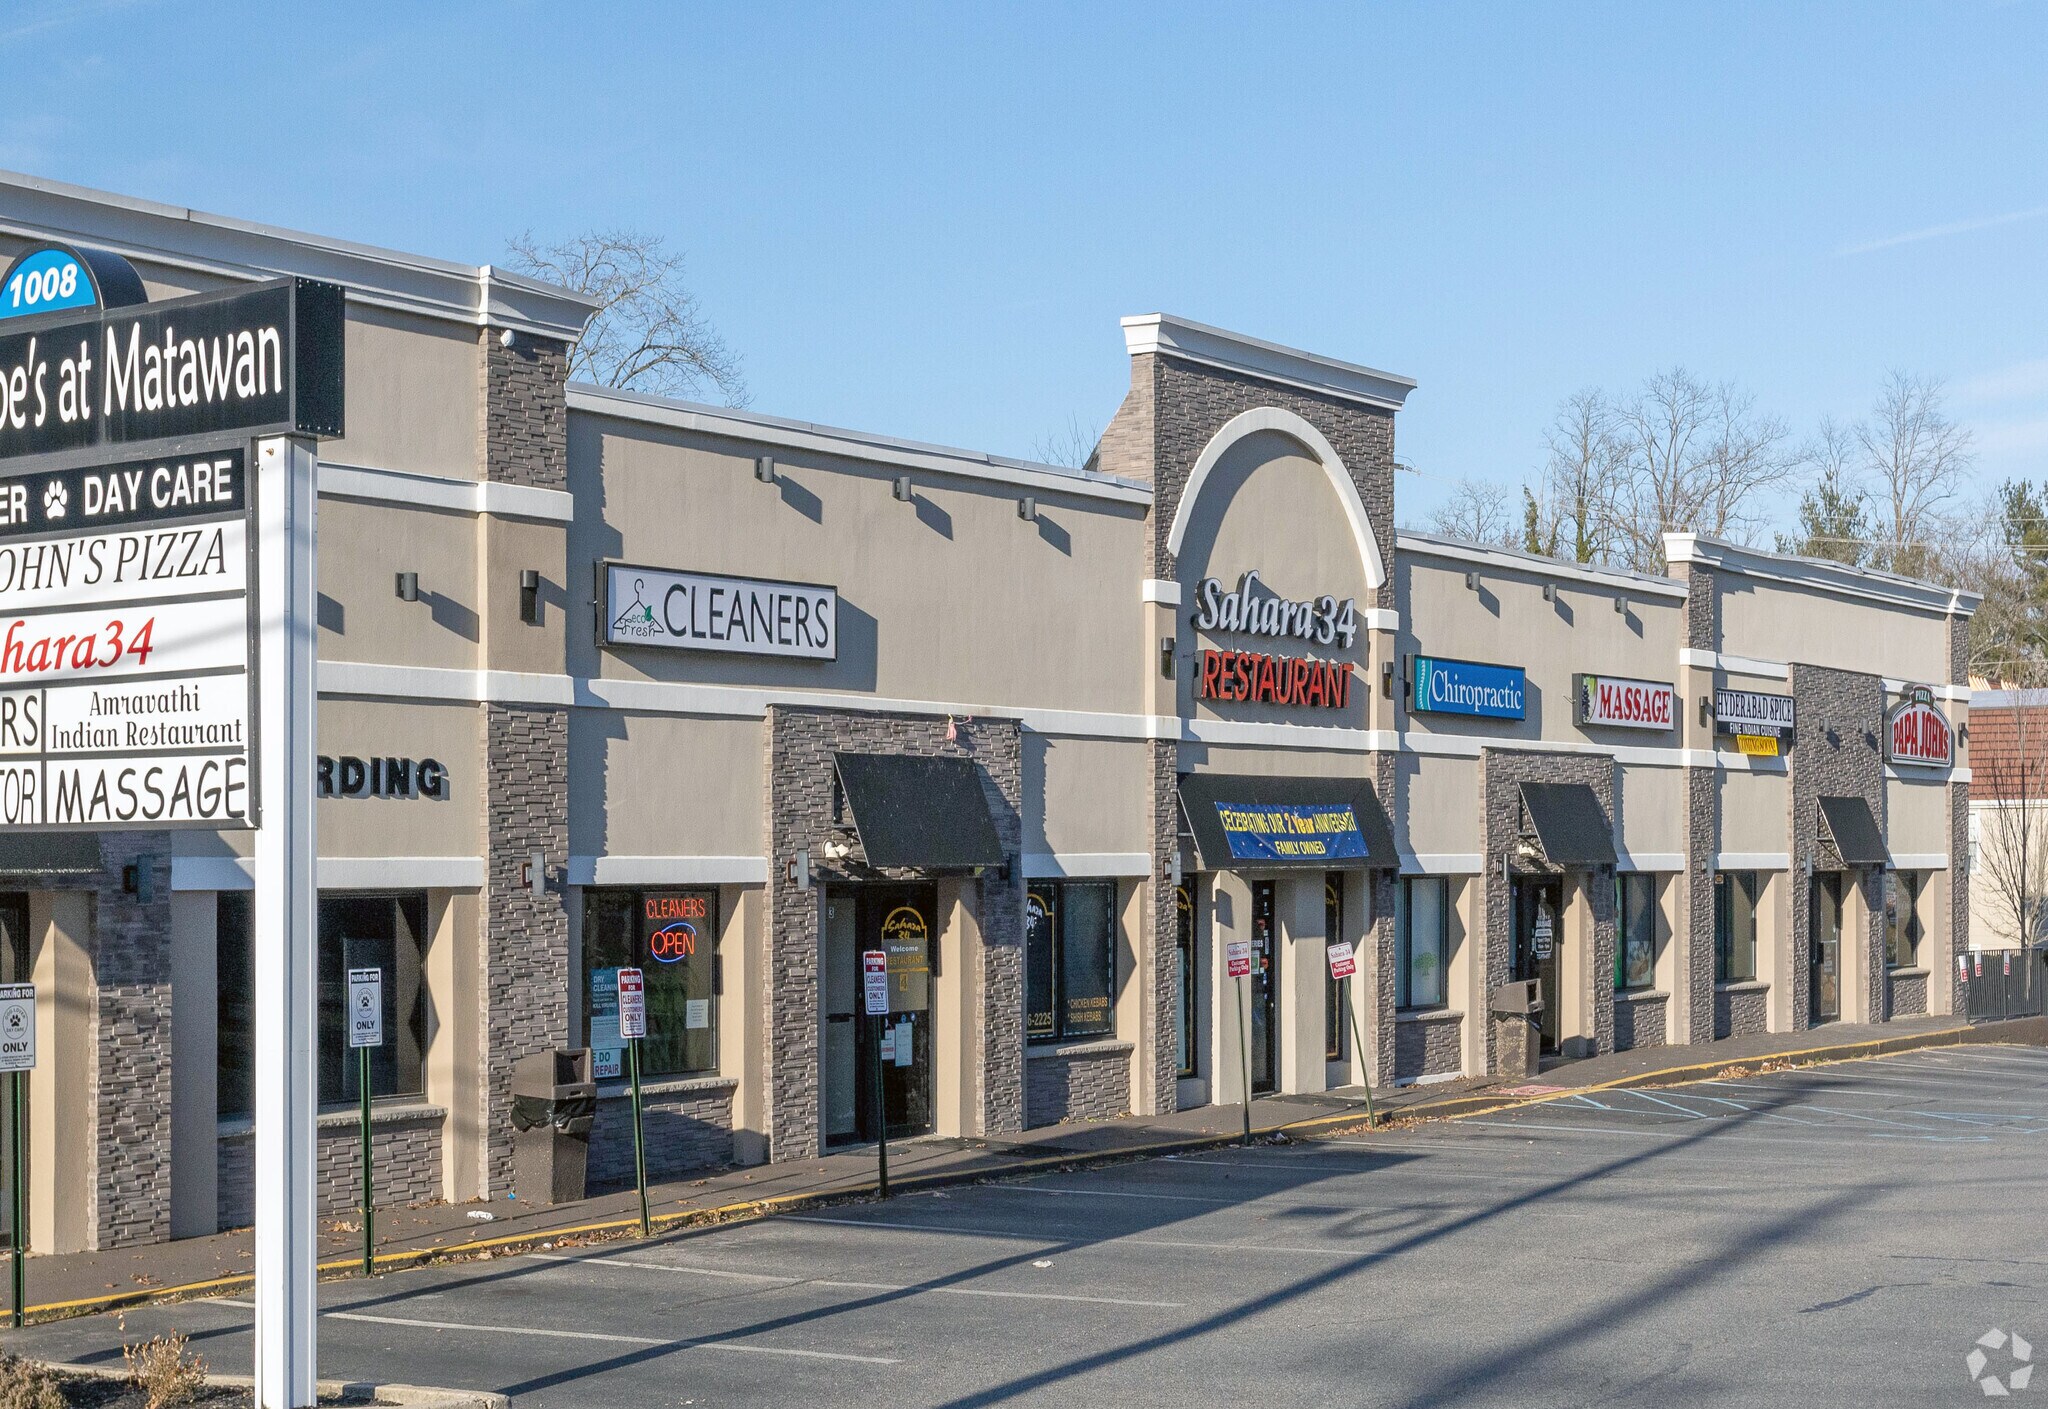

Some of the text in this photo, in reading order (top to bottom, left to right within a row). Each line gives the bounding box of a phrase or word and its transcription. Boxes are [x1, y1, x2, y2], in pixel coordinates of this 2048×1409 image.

[10, 263, 77, 308] 1008
[59, 340, 92, 423] at
[104, 321, 282, 417] Matawan
[84, 470, 143, 516] DAY
[151, 459, 232, 509] CARE
[0, 527, 227, 593] OHN'S PIZZA
[631, 614, 646, 624] eco
[663, 583, 830, 649] CLEANERS
[1200, 649, 1355, 709] RESTAURANT
[89, 684, 201, 716] Amravathi
[1431, 670, 1522, 713] Chiropractic
[1599, 684, 1671, 724] MASSAGE
[1717, 692, 1792, 722] HYDERABAD SPICE
[1, 694, 39, 747] RS
[52, 719, 242, 749] Indian Restaurant
[1893, 711, 1919, 756] PAPA
[0, 757, 247, 824] OR MASSAGE
[1220, 810, 1270, 833] CELEBRATING
[1267, 813, 1287, 833] OUR
[1284, 813, 1295, 834] 2
[1312, 812, 1357, 833] ANNIVERSARY
[1275, 841, 1326, 855] FAMILY OWNED
[646, 899, 706, 918] CLEANERS
[651, 931, 695, 955] OPEN
[890, 945, 920, 954] Welcome
[621, 975, 641, 984] PARKING
[22, 988, 34, 998] FOR
[623, 994, 643, 1005] CLEANERS
[869, 991, 884, 1000] ONLY
[356, 1020, 375, 1030] ONLY
[624, 1013, 642, 1022] ONLY
[2, 1041, 28, 1053] ONLY
[599, 1051, 611, 1063] DO
[595, 1063, 619, 1077] REPAIR
